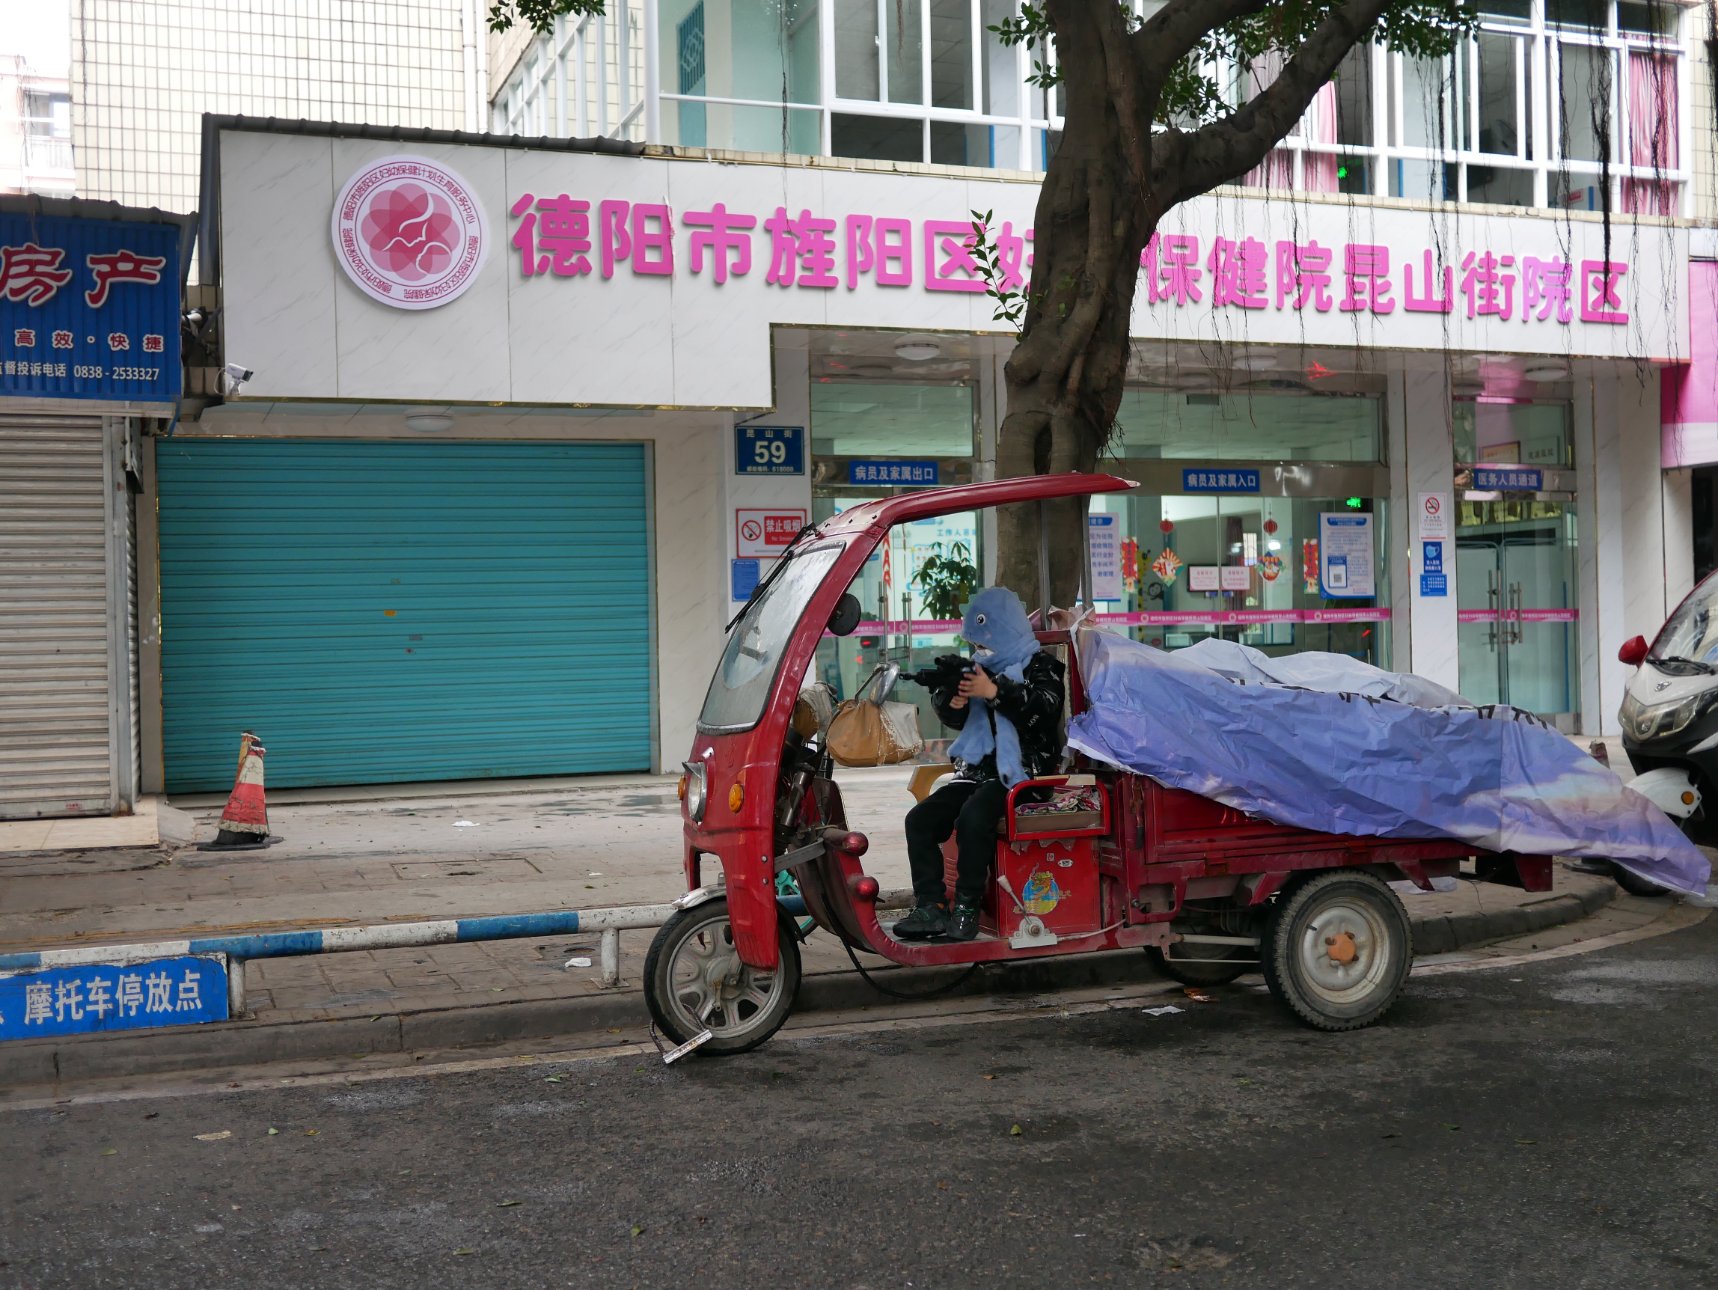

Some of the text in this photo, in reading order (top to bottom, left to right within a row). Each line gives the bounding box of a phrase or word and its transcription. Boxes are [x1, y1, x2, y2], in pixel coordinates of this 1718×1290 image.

[0, 243, 166, 308] 房产
[0, 360, 66, 377] 督投诉电话
[754, 441, 786, 464] 59
[855, 465, 934, 481] 病员及家属出口
[1188, 473, 1256, 488] 病员及家属入口
[1477, 472, 1539, 487] 医务人员通道
[24, 968, 203, 1026] 摩托车停放点
